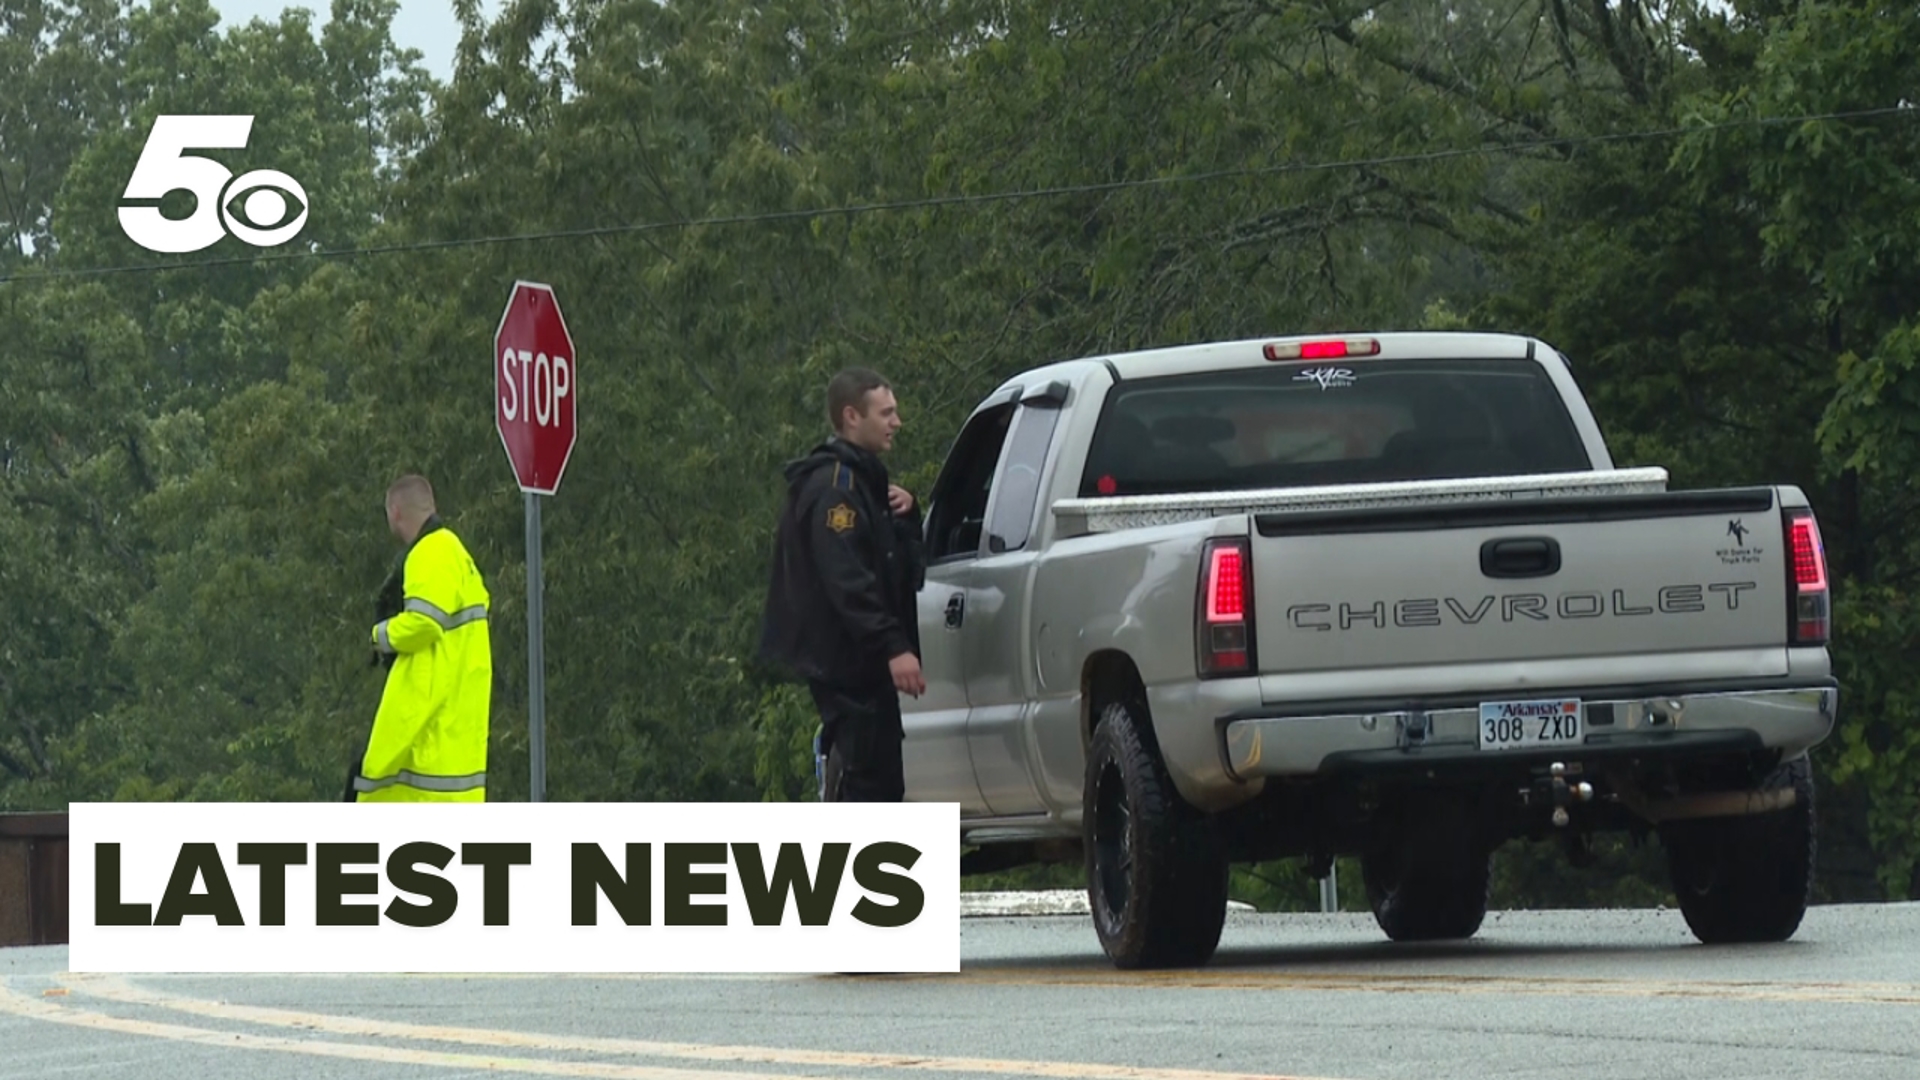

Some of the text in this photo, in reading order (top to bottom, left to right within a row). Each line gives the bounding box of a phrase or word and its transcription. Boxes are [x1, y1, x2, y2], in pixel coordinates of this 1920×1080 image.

[502, 347, 569, 427] STOP
[1287, 582, 1756, 631] CHEVROLET
[1485, 715, 1577, 743] 308 ZXD
[1502, 703, 1558, 717] Arkansas
